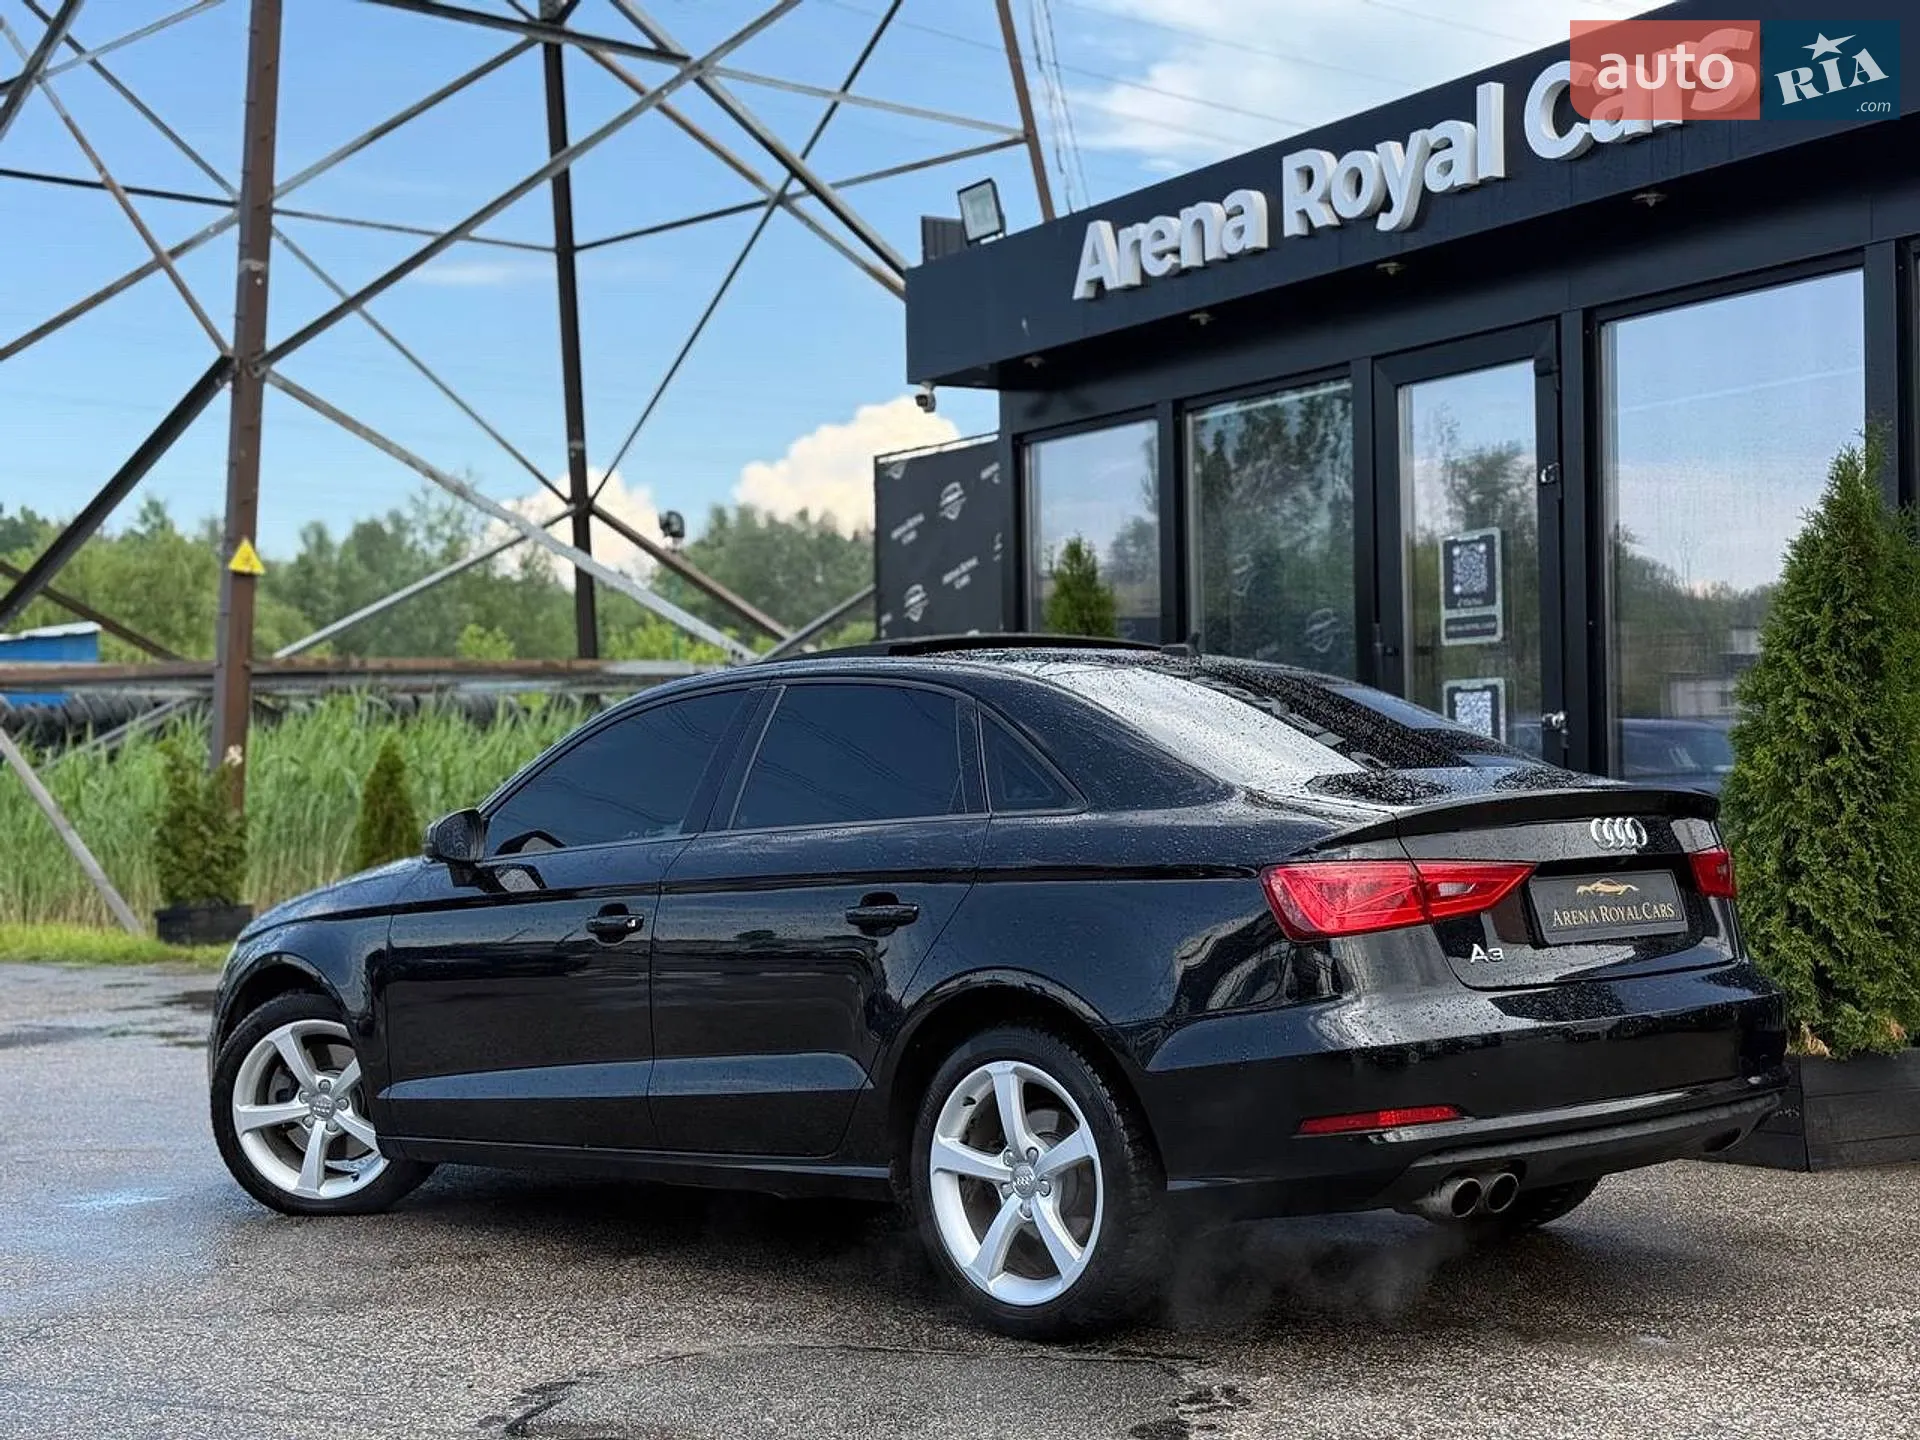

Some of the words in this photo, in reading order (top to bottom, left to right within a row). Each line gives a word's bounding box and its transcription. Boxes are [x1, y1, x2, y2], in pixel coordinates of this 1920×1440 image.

[1073, 188, 1269, 300] Arena
[1282, 82, 1505, 237] Royal
[1524, 28, 1757, 160] Cars
[1552, 909, 1597, 928] ARENA
[1599, 904, 1643, 924] ROYAL
[1642, 901, 1676, 919] CARS
[1470, 943, 1504, 964] A3
